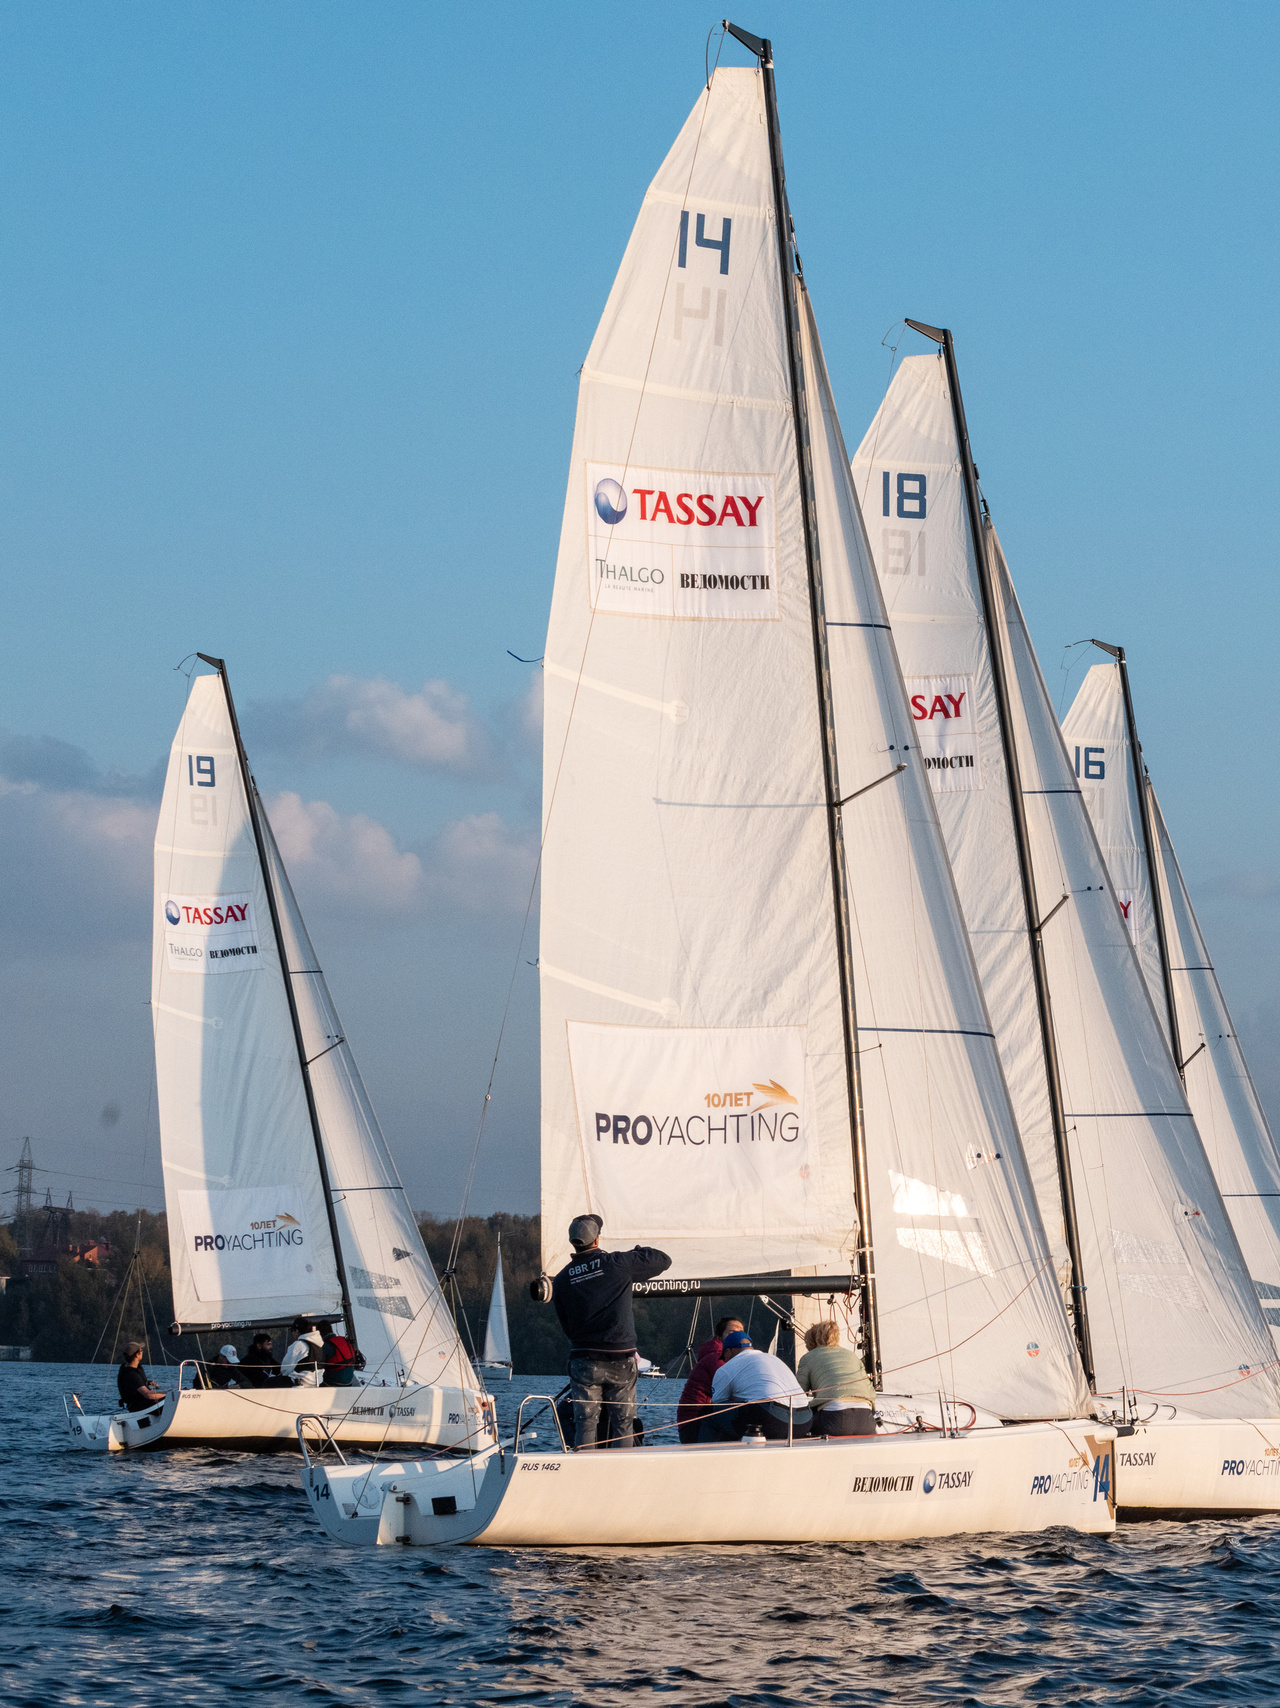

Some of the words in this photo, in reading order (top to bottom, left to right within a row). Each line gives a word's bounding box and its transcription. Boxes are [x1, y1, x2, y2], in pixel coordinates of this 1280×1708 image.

[678, 210, 732, 276] 14
[882, 471, 927, 520] 18
[632, 488, 765, 527] TASSAY
[595, 558, 665, 585] THALGO
[679, 573, 771, 590] ВЕДОМОСТИ
[910, 692, 966, 721] SAY
[188, 754, 216, 788] 19
[924, 754, 974, 770] ОМОСТИ
[1075, 746, 1105, 780] 16
[182, 902, 249, 925] TASSAY
[168, 942, 203, 957] THALGO
[209, 945, 258, 959] ВЕДОМОСТИ
[595, 1111, 800, 1146] PROYACHTING
[194, 1229, 304, 1252] PROYACHTING
[568, 1263, 589, 1276] GBR
[589, 1258, 601, 1270] 77
[632, 1279, 701, 1294] ro-yachting.ru
[396, 1407, 416, 1416] TASSAY
[71, 1425, 83, 1437] 19
[482, 1409, 494, 1436] 19
[520, 1462, 539, 1471] RUS
[541, 1462, 561, 1472] 1462
[1119, 1452, 1157, 1467] TASSAY
[852, 1475, 915, 1494] ВЕДОМОСТИ
[938, 1470, 974, 1490] TASSAY
[1030, 1470, 1089, 1496] PROYACHTING
[1092, 1453, 1110, 1502] 14
[313, 1483, 331, 1502] 14
